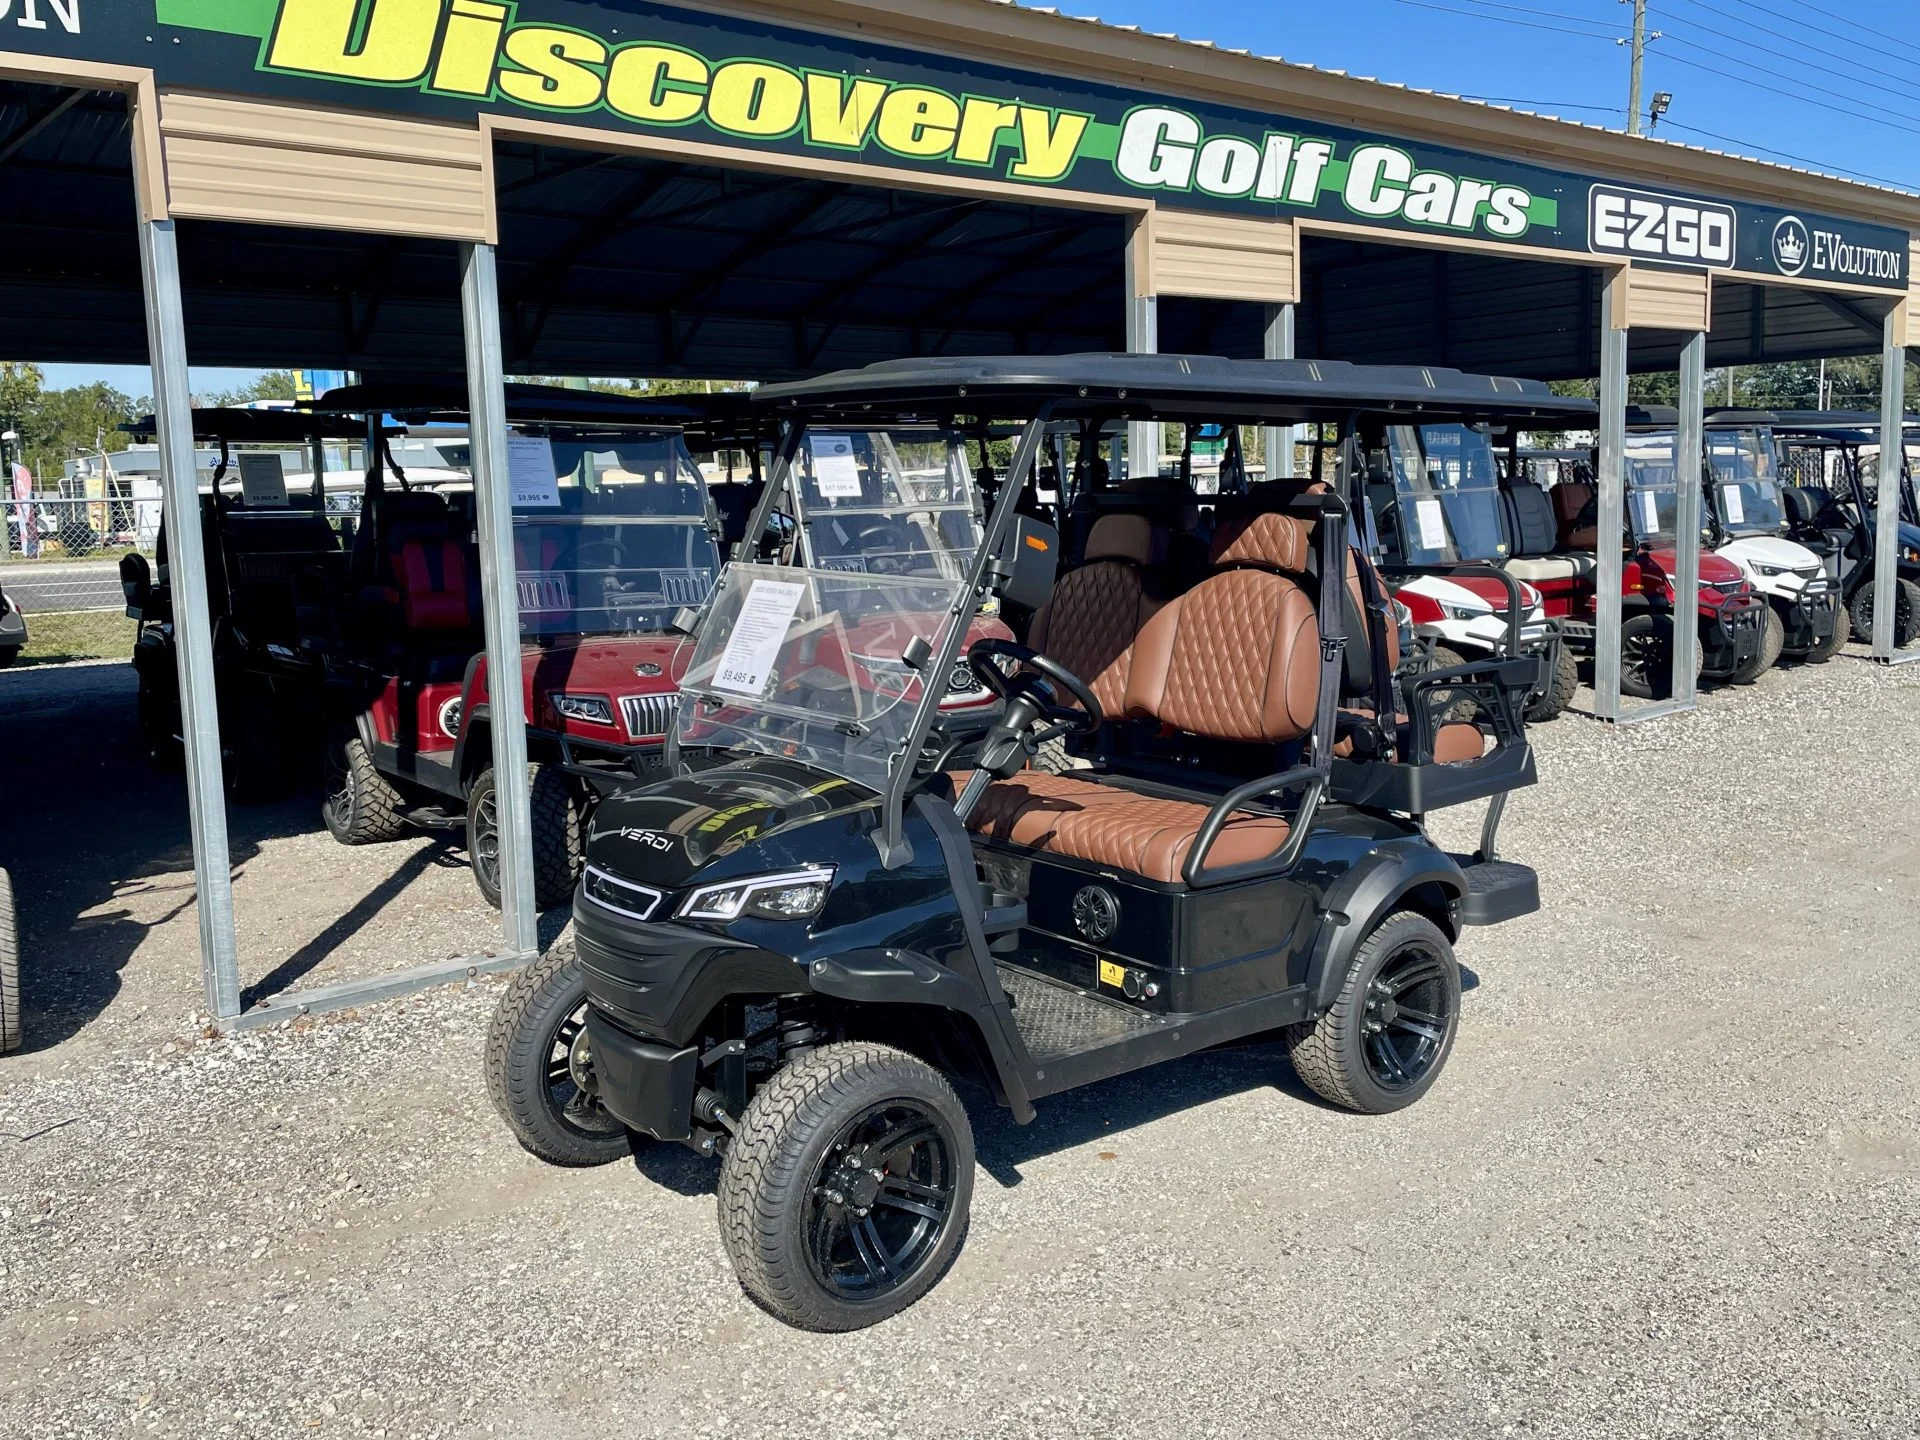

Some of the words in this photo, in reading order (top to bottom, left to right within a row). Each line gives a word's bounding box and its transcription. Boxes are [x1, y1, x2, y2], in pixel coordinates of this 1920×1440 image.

[263, 0, 1091, 180] Discovery
[1115, 105, 1334, 205] Golf
[1344, 145, 1531, 236] Cars
[1595, 193, 1732, 261] EZGO
[722, 669, 747, 683] $9,495
[619, 825, 674, 852] VERDI
